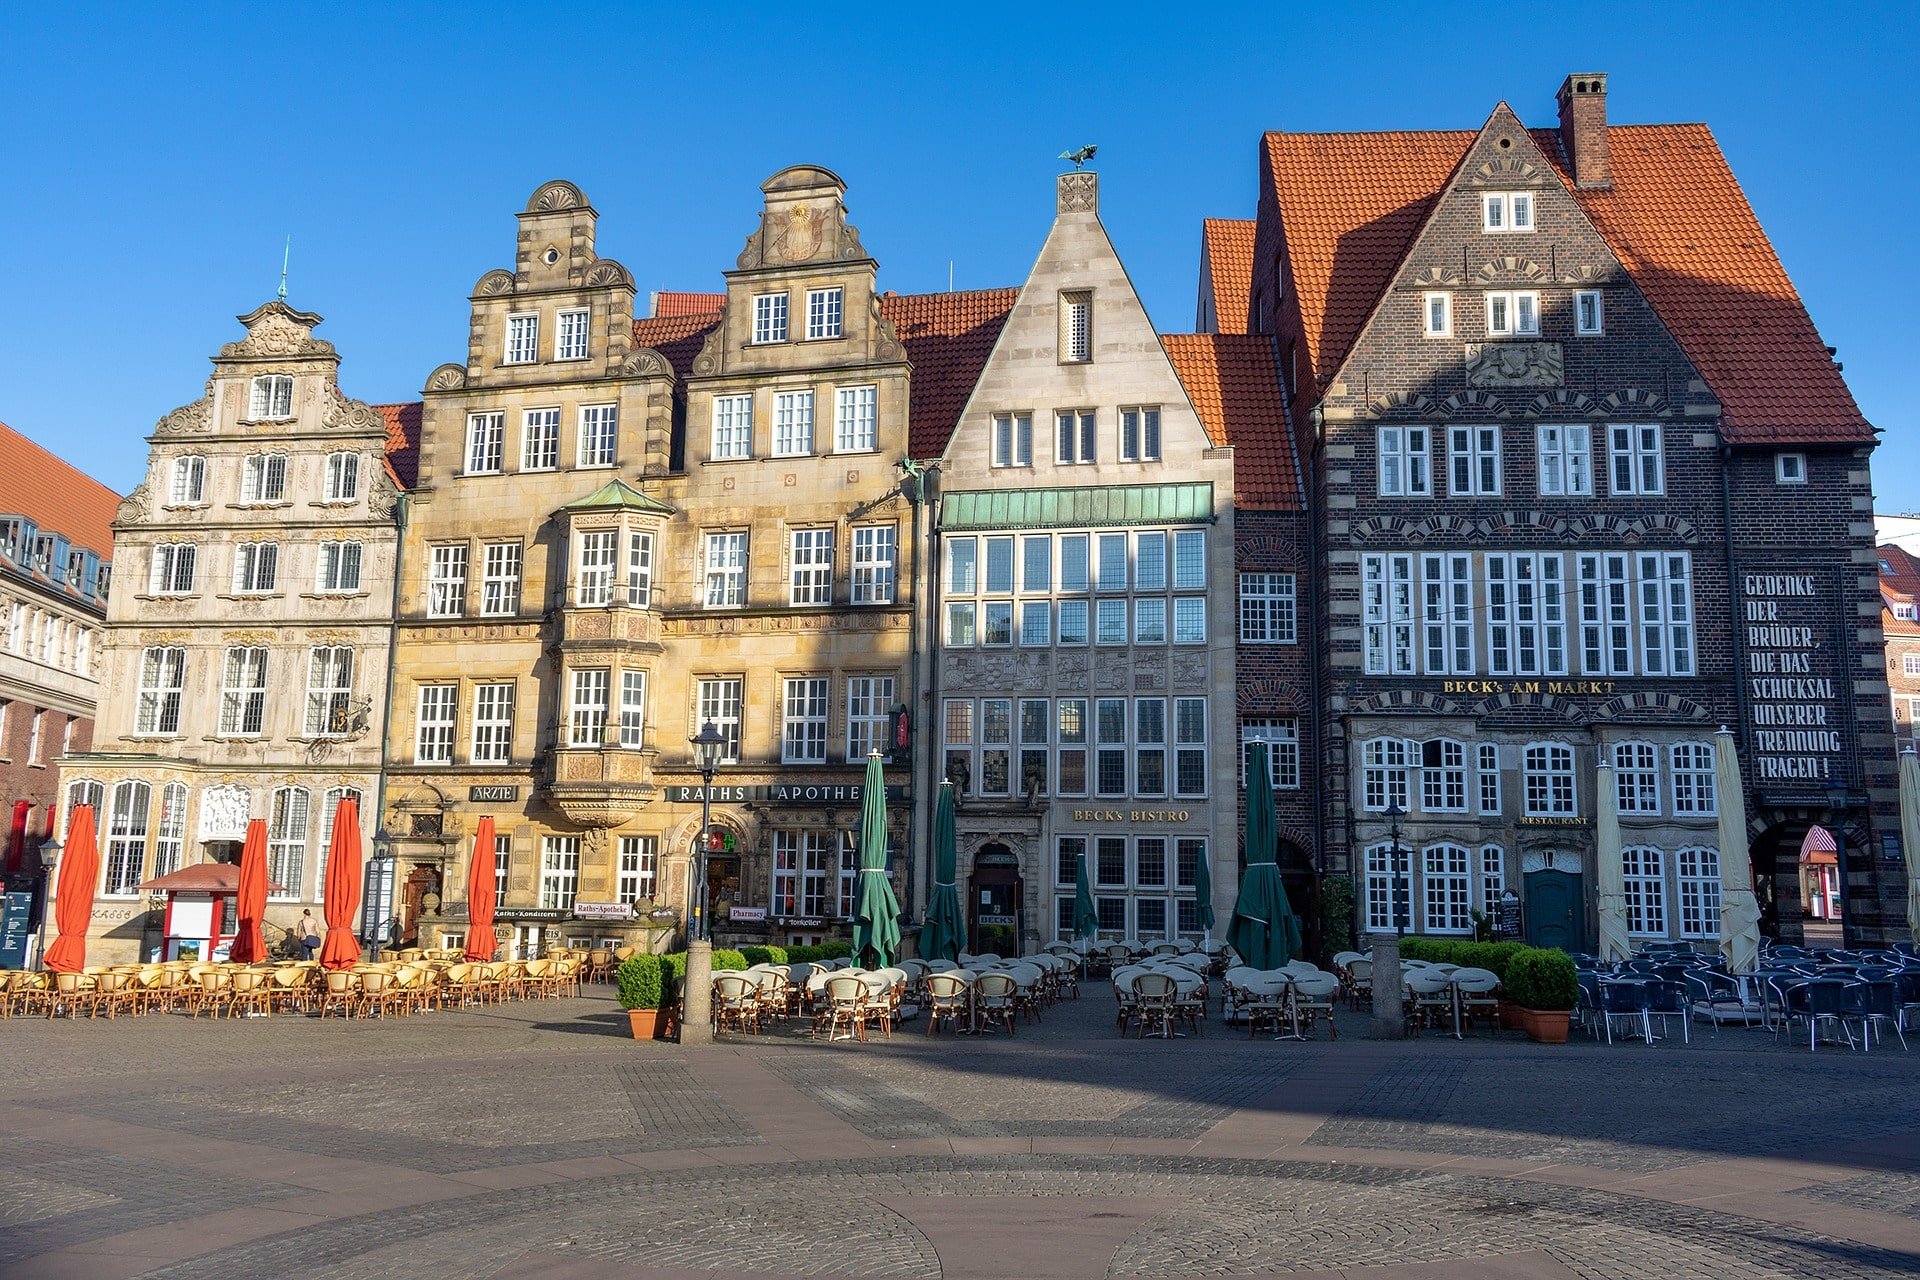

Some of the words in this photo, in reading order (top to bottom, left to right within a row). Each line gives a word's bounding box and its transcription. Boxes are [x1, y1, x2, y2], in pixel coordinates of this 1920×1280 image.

[1745, 575, 1816, 596] GEDENKE
[1747, 601, 1777, 621] DER
[1749, 623, 1820, 648] BRÜDER,
[1751, 652, 1776, 672] DIE
[1781, 652, 1810, 673] DAS
[1512, 682, 1539, 693] AM
[1549, 682, 1615, 694] MARKT
[1752, 678, 1835, 699] SCHICKSAL
[1754, 704, 1827, 725] UNSERER
[1756, 731, 1841, 752] TRENNUNG
[474, 786, 512, 799] ÄRZTE
[681, 787, 744, 800] RATHS
[777, 787, 889, 800] APOTHEE
[1131, 810, 1189, 822] BISTRO
[1521, 817, 1588, 825] RESTAURANT
[577, 904, 628, 915] Raths-Apotheke
[732, 909, 764, 919] Pharmacy
[496, 929, 510, 938] EIS
[545, 929, 559, 938] EIS
